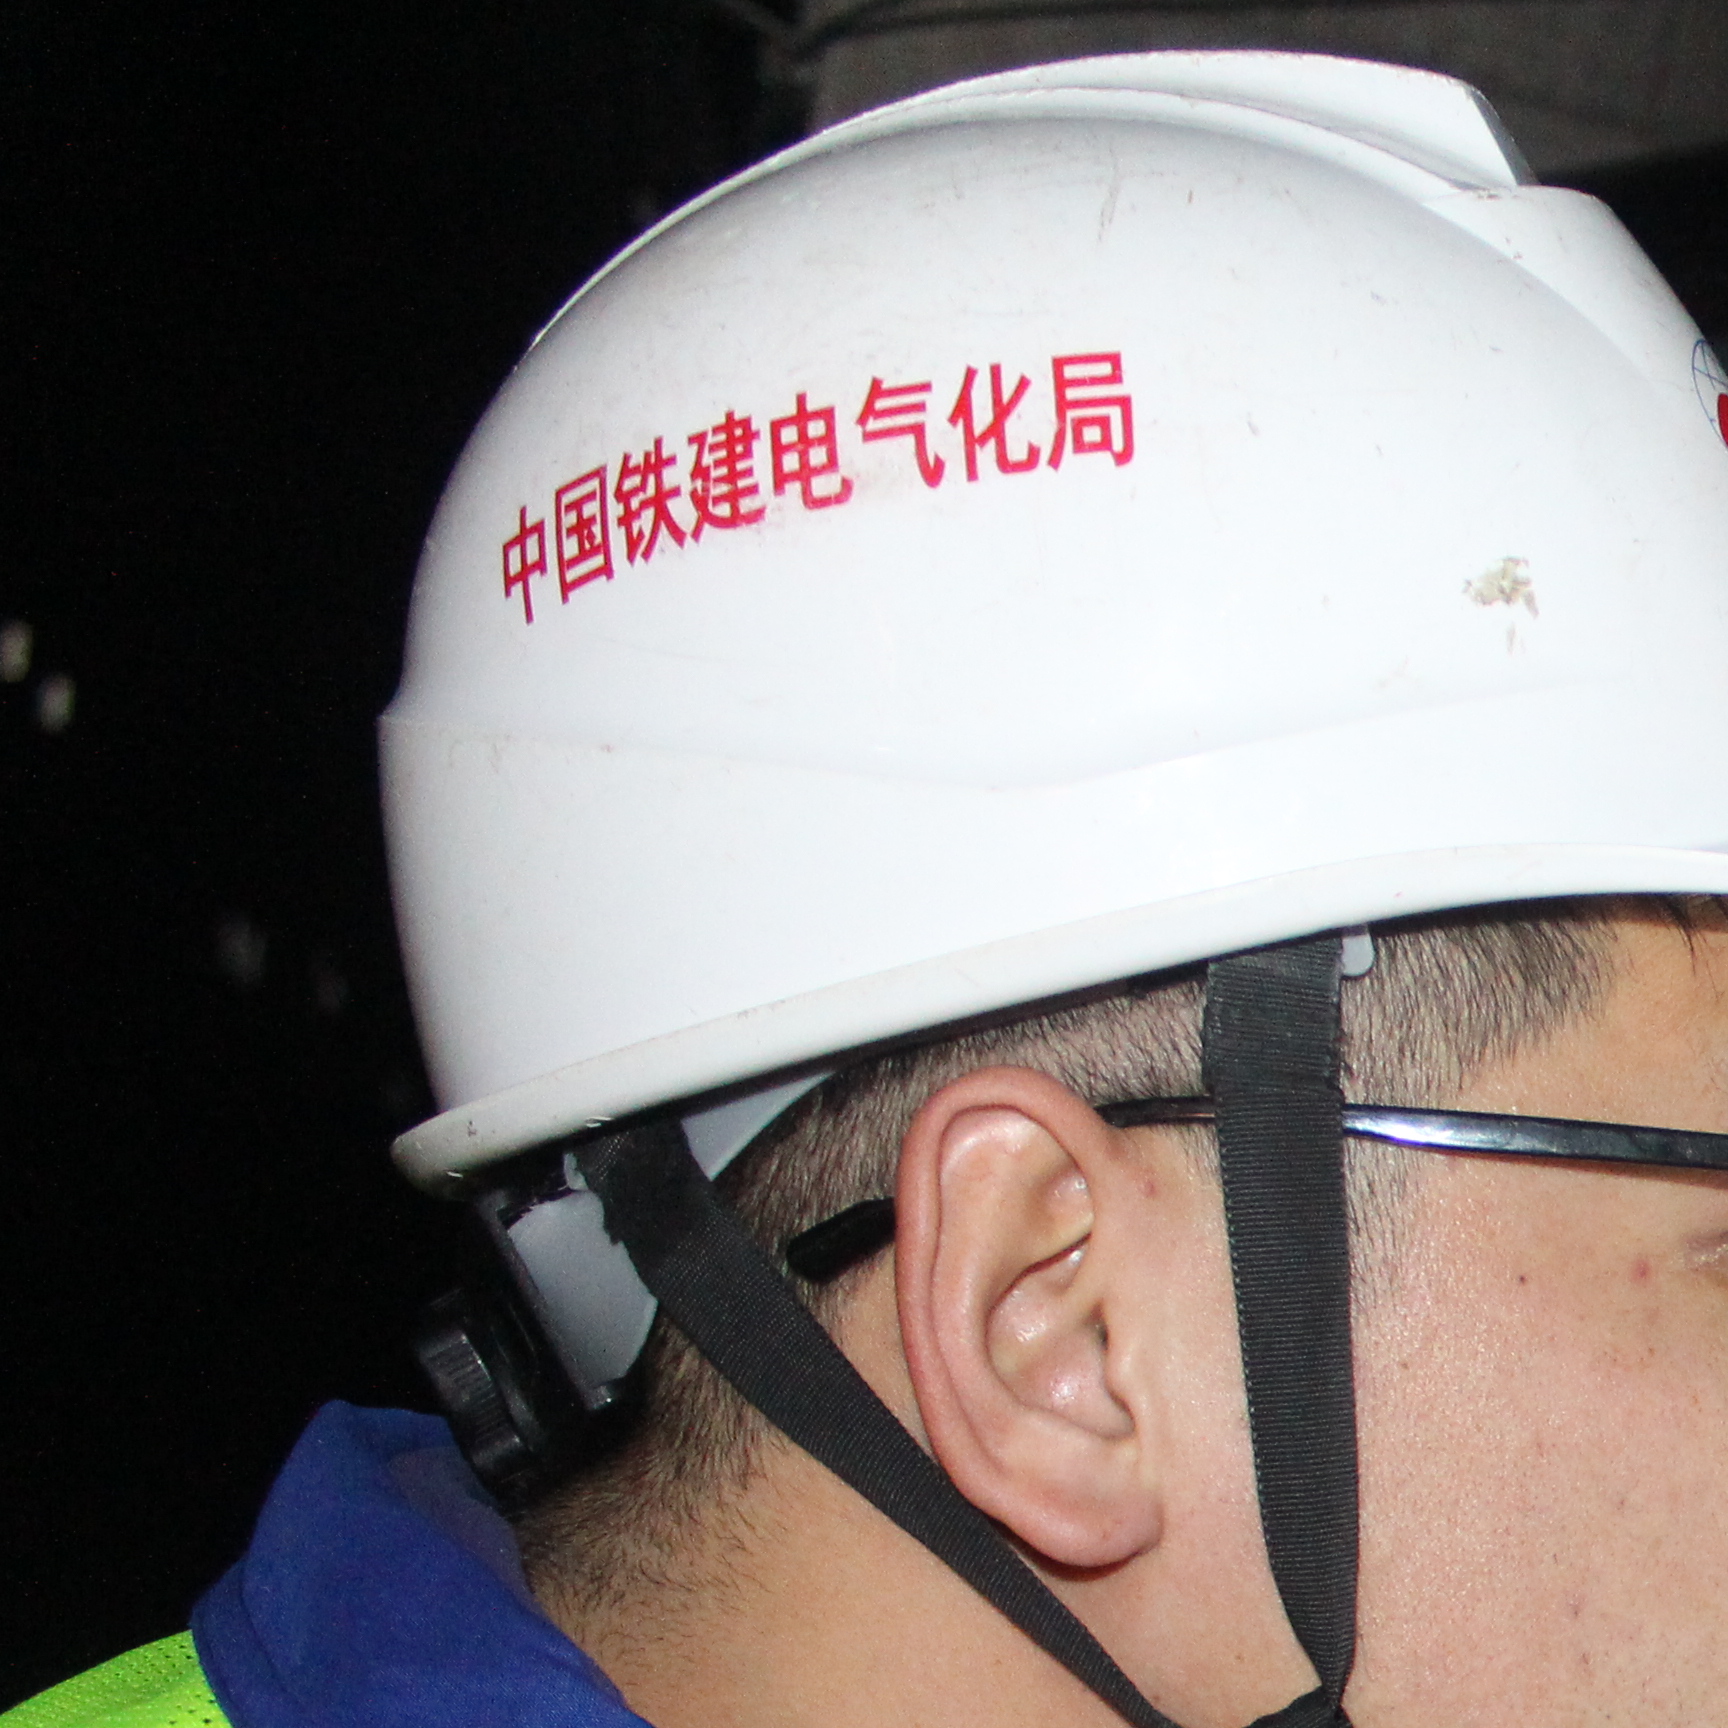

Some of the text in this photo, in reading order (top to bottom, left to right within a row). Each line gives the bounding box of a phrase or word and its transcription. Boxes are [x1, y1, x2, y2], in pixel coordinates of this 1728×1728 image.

[502, 351, 1136, 625] 中国铁建电气化局
